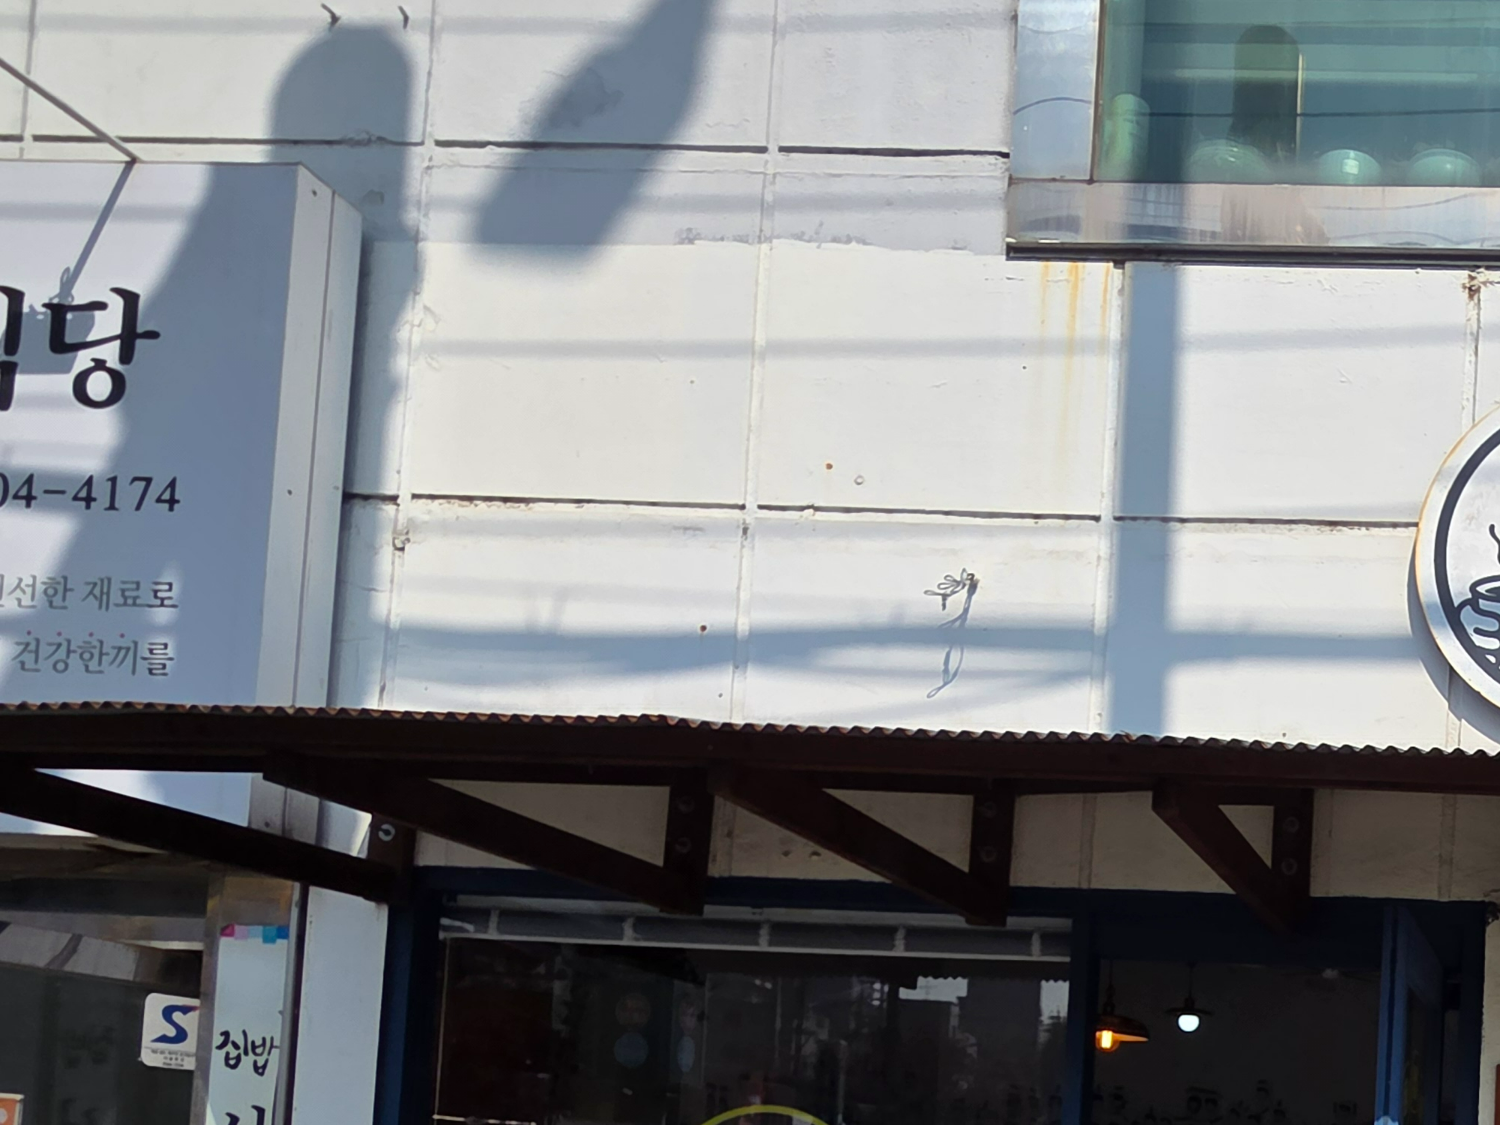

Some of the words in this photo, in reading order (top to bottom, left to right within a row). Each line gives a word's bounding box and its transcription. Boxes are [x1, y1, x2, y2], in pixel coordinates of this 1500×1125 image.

[0, 573, 75, 610] 선한
[81, 576, 179, 612] 재료로
[215, 1029, 280, 1077] 집밥
